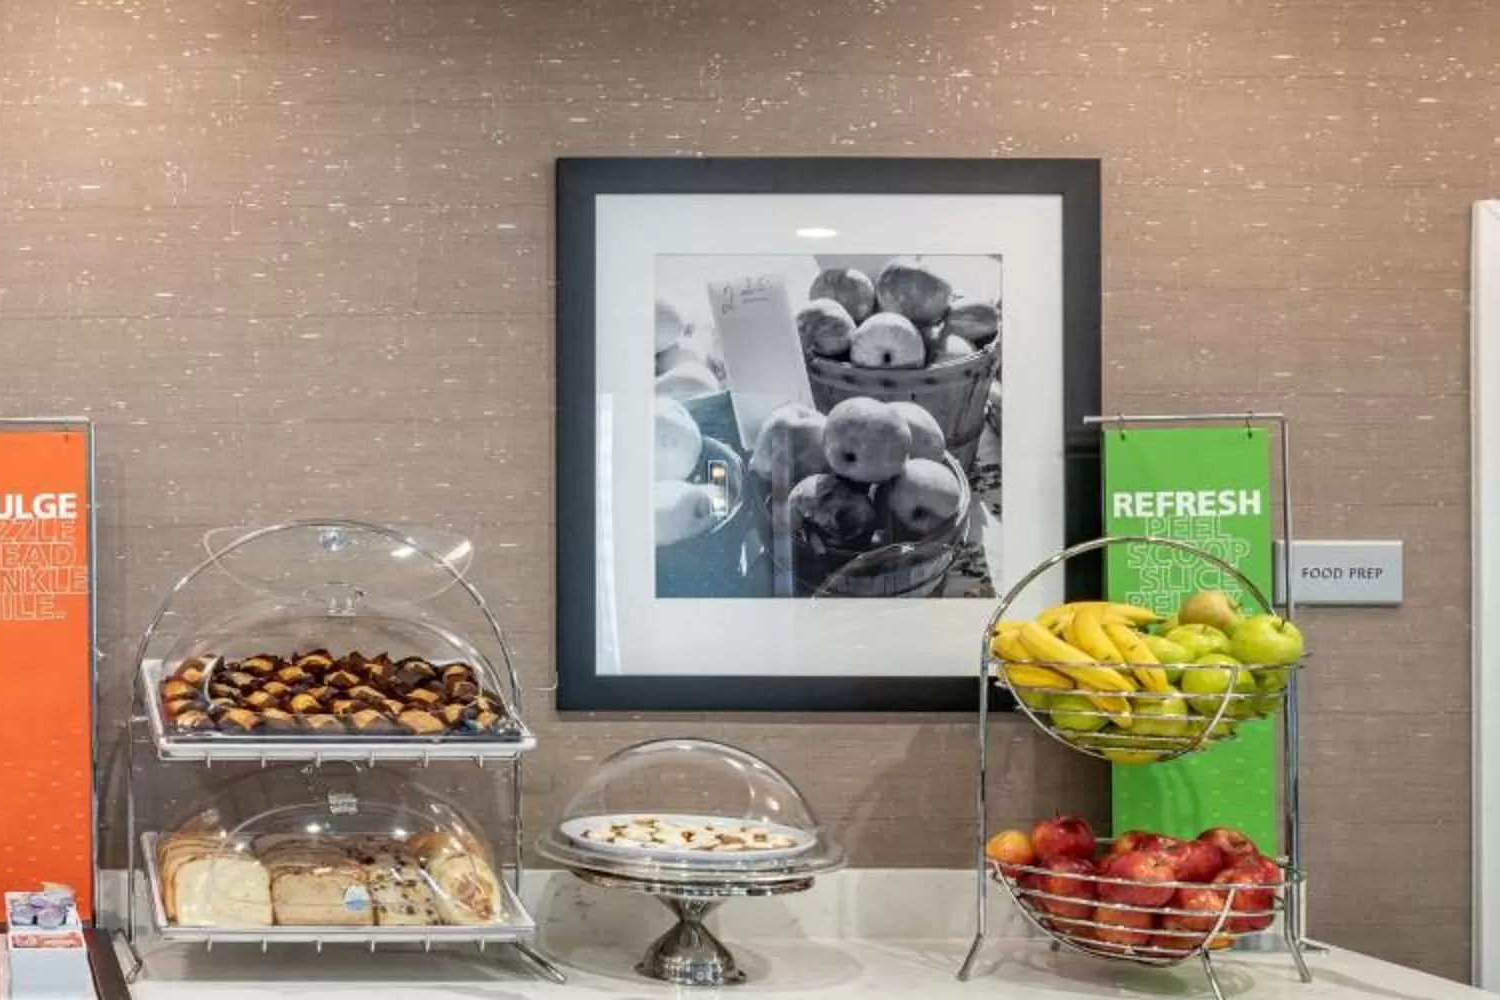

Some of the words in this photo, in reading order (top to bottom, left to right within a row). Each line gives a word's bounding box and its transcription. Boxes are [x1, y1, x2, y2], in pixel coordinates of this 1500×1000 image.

[1112, 489, 1261, 519] REFRESH
[1145, 515, 1232, 541] PEEL
[1127, 540, 1251, 569] SCOOP
[1140, 567, 1239, 594] SLICE
[1301, 567, 1343, 580] FOOD
[1349, 567, 1383, 580] PREP
